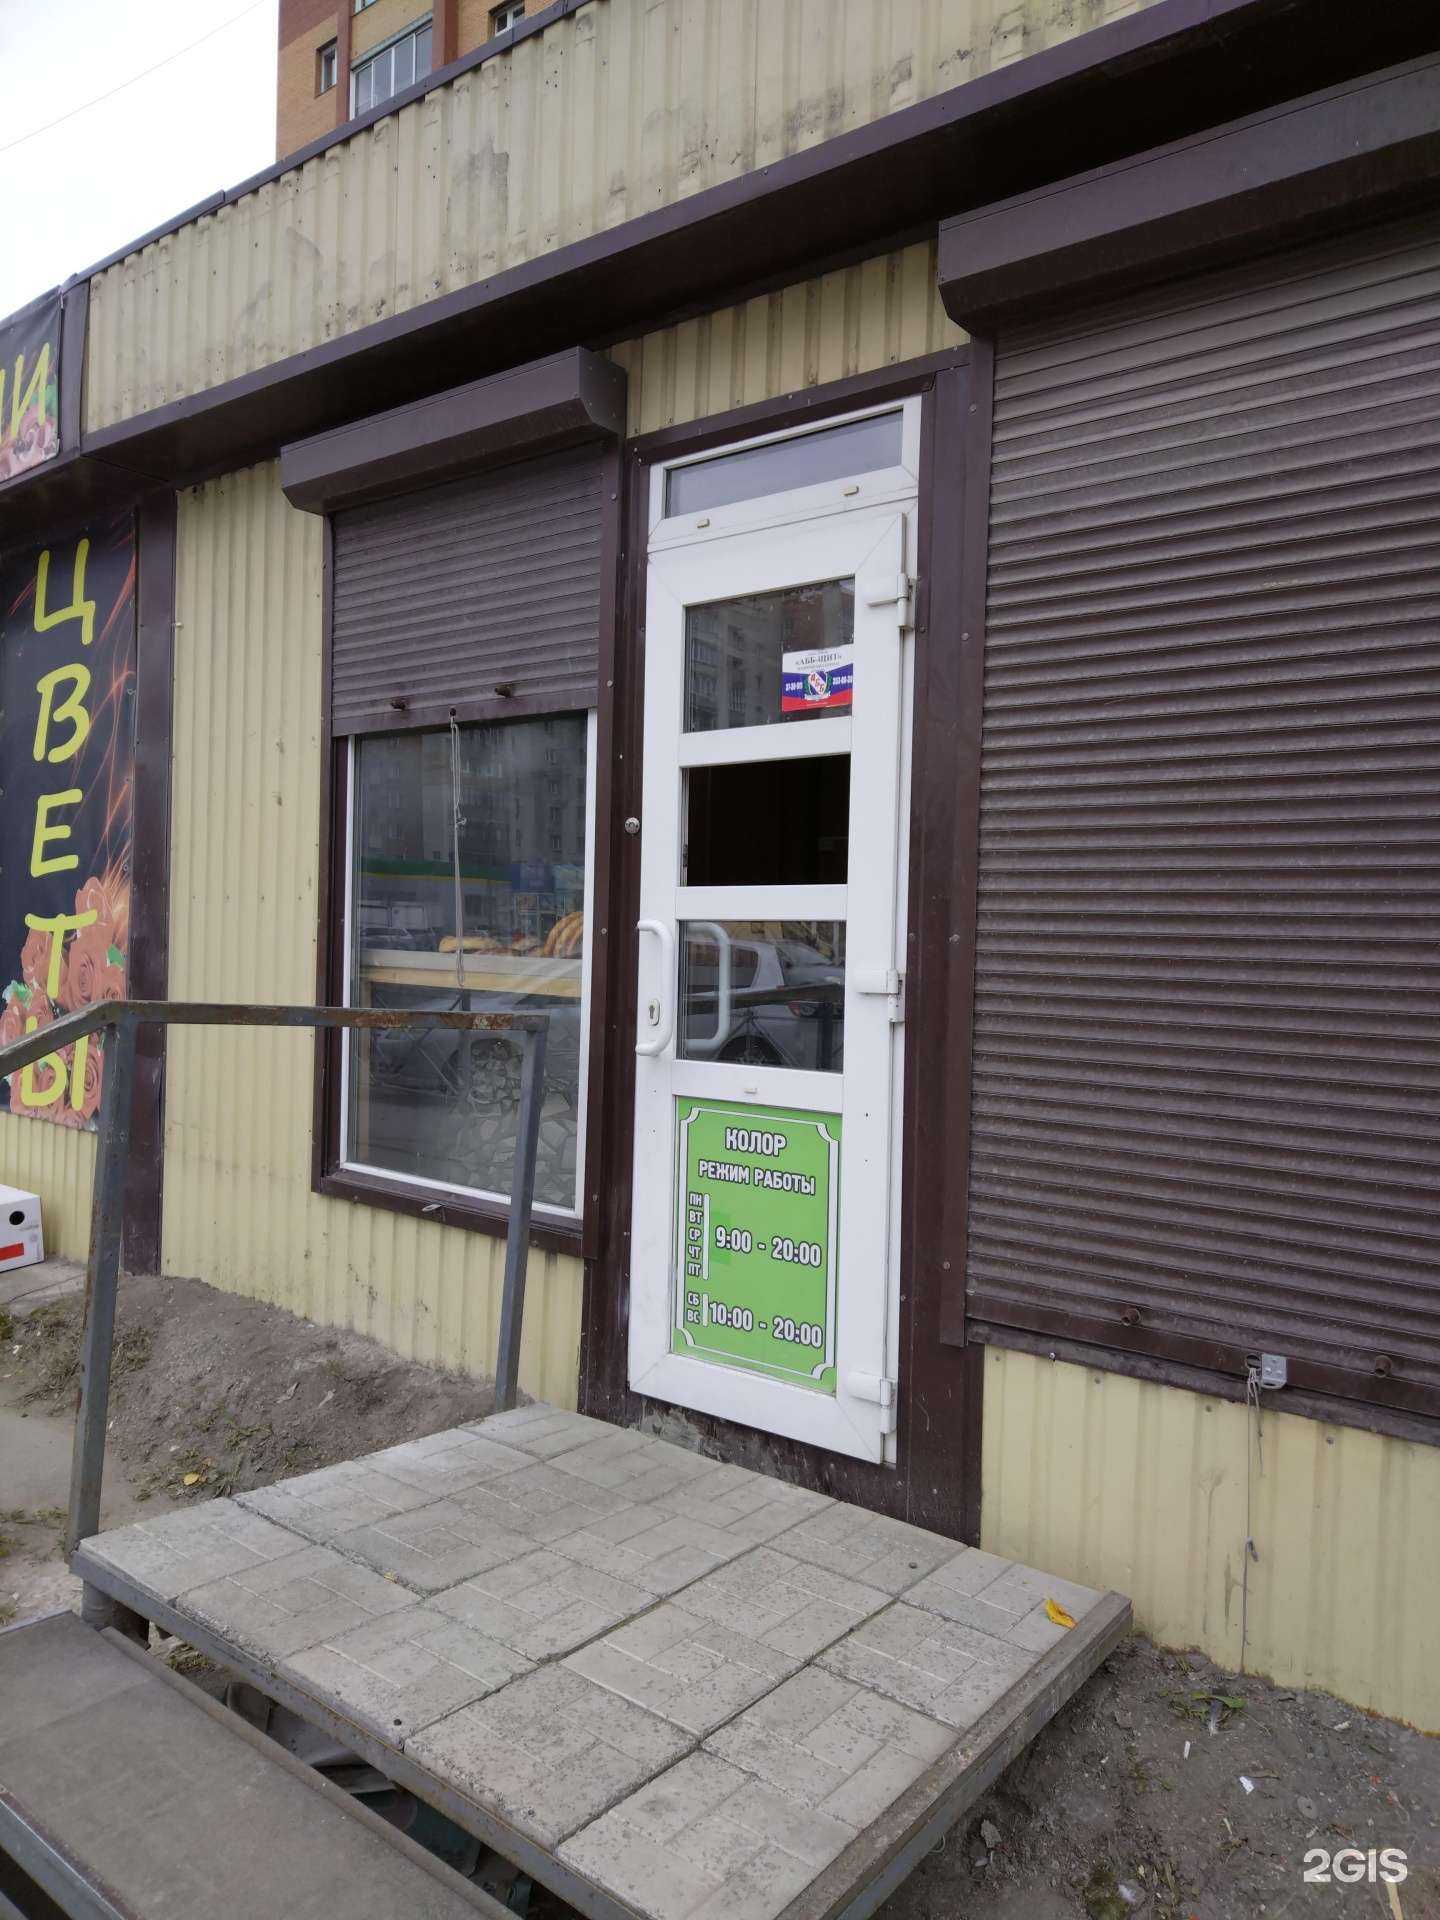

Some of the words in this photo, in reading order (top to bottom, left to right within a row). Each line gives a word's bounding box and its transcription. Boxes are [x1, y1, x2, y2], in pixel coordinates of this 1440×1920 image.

[21, 538, 97, 1111] ЦВЕТЫ
[726, 1127, 787, 1157] КОЛОР
[699, 1159, 750, 1185] РЕЖИМ
[754, 1167, 815, 1195] РАБОТЫ
[689, 1192, 703, 1207] ПН
[689, 1209, 703, 1224] ВТ
[689, 1227, 701, 1241] СР
[688, 1245, 701, 1259] ЧТ
[716, 1225, 752, 1253] 9:00
[772, 1236, 822, 1267] 20:00
[688, 1262, 701, 1276] ПТ
[688, 1291, 700, 1306] СБ
[687, 1309, 700, 1323] ВС
[709, 1301, 753, 1332] 10:00
[773, 1316, 823, 1349] 20:00
